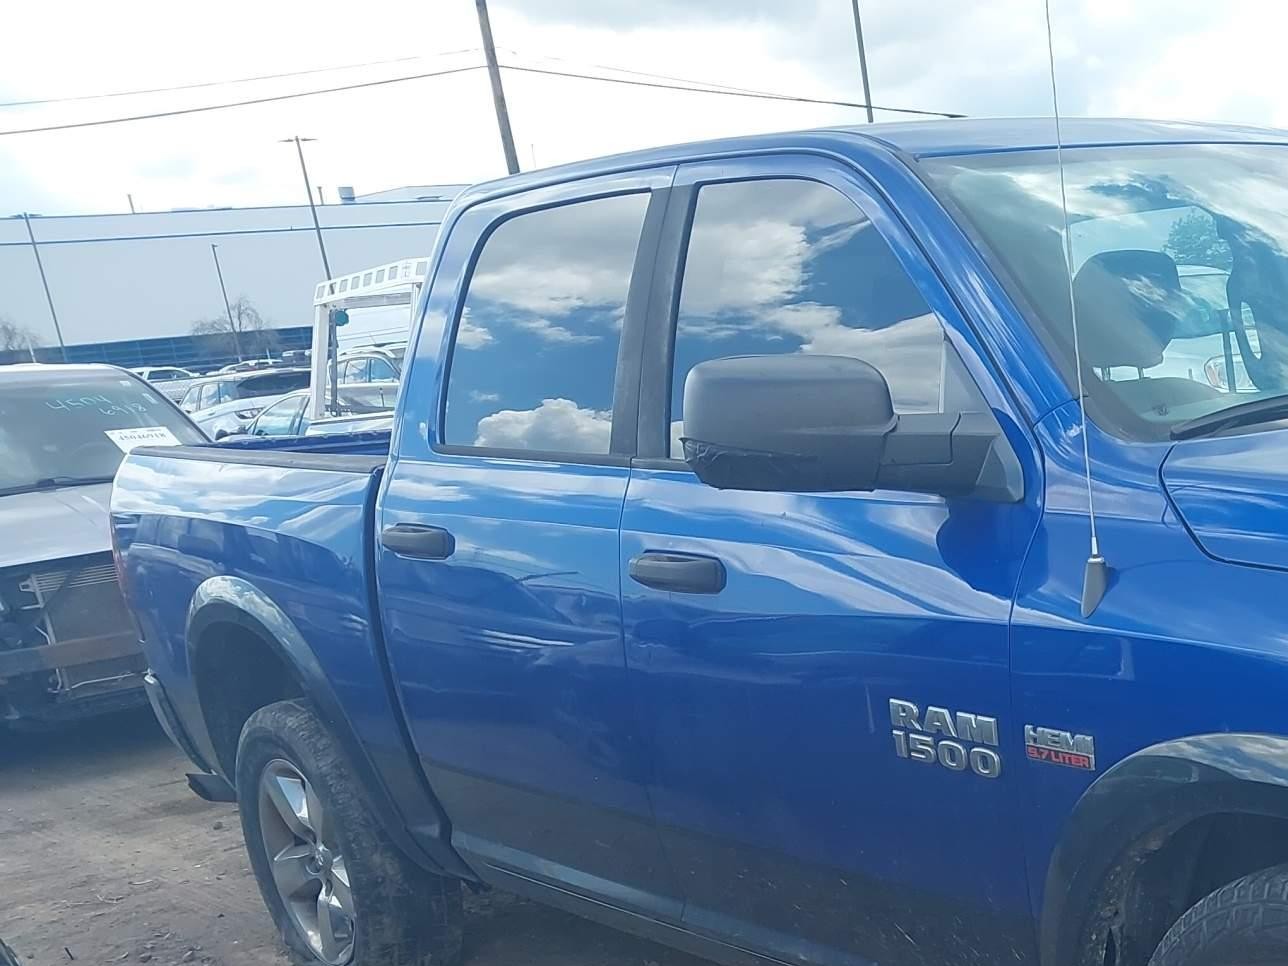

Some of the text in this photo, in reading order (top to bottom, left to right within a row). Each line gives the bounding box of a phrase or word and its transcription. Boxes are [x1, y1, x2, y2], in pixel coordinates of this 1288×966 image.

[889, 697, 999, 747] RAM
[1024, 724, 1095, 756] HEMI
[891, 729, 1002, 779] 1500
[1026, 746, 1091, 769] 5.7 LITER
